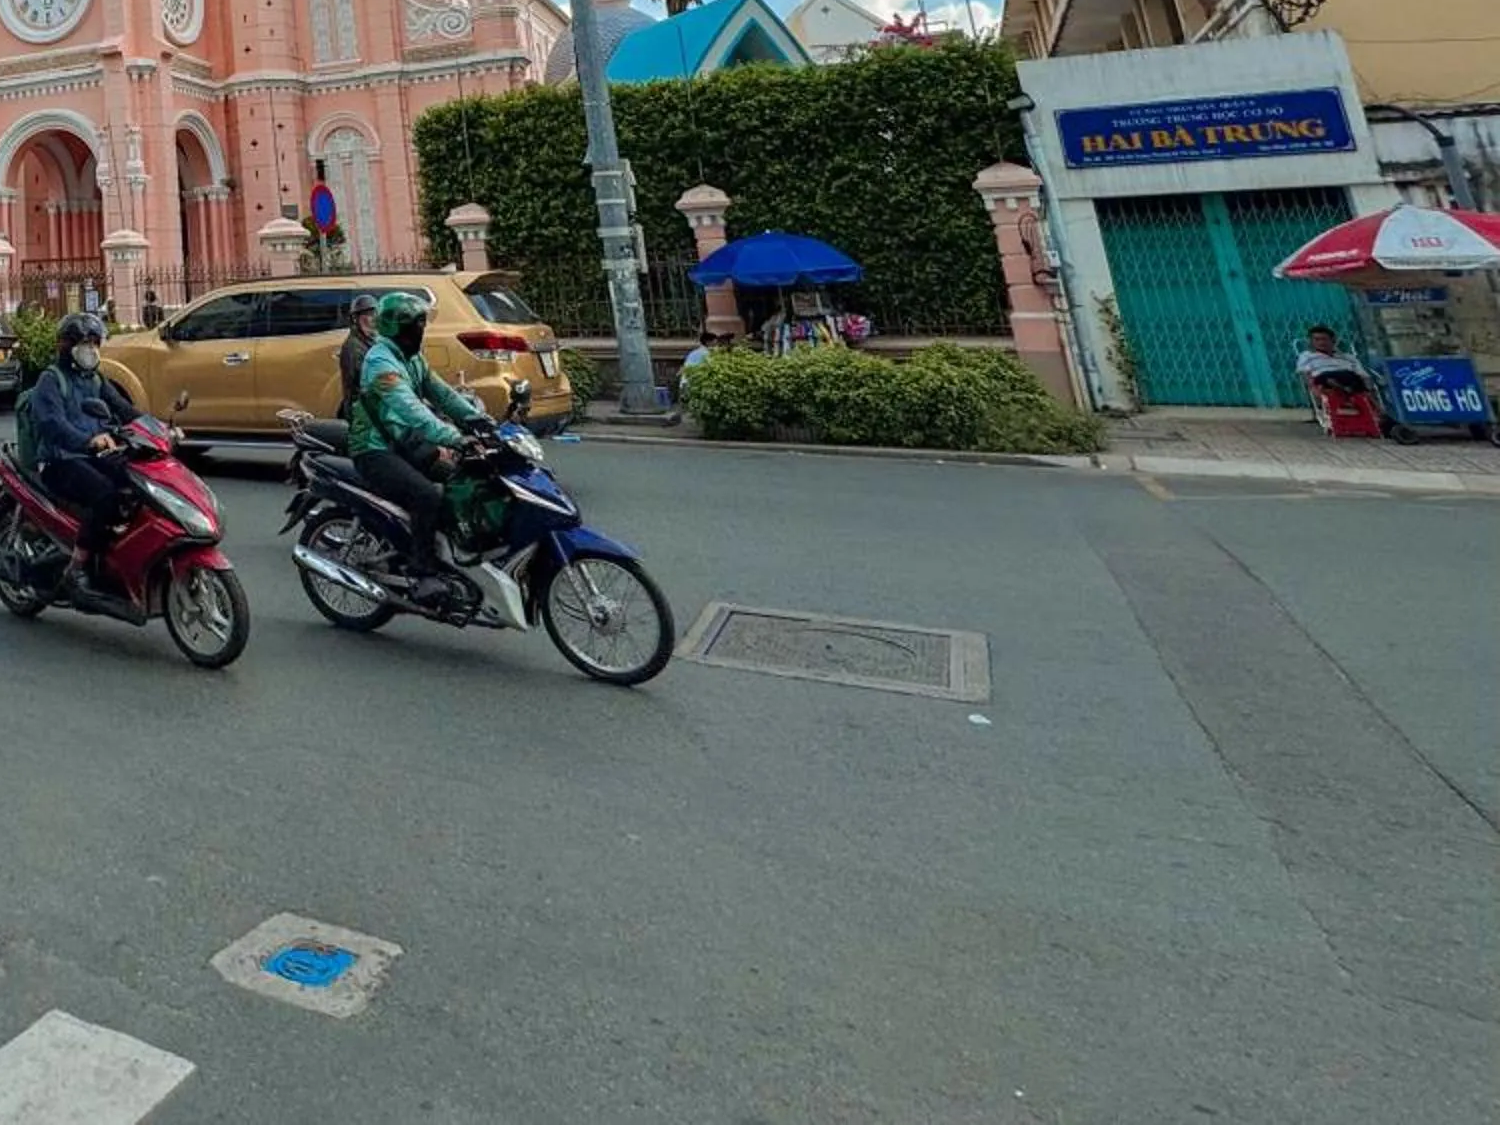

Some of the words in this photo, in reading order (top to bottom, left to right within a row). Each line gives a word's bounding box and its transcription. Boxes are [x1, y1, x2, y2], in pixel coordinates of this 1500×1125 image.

[1082, 131, 1143, 152] HAI
[1150, 124, 1196, 148] BÀ
[1197, 118, 1326, 144] TRƯNG
